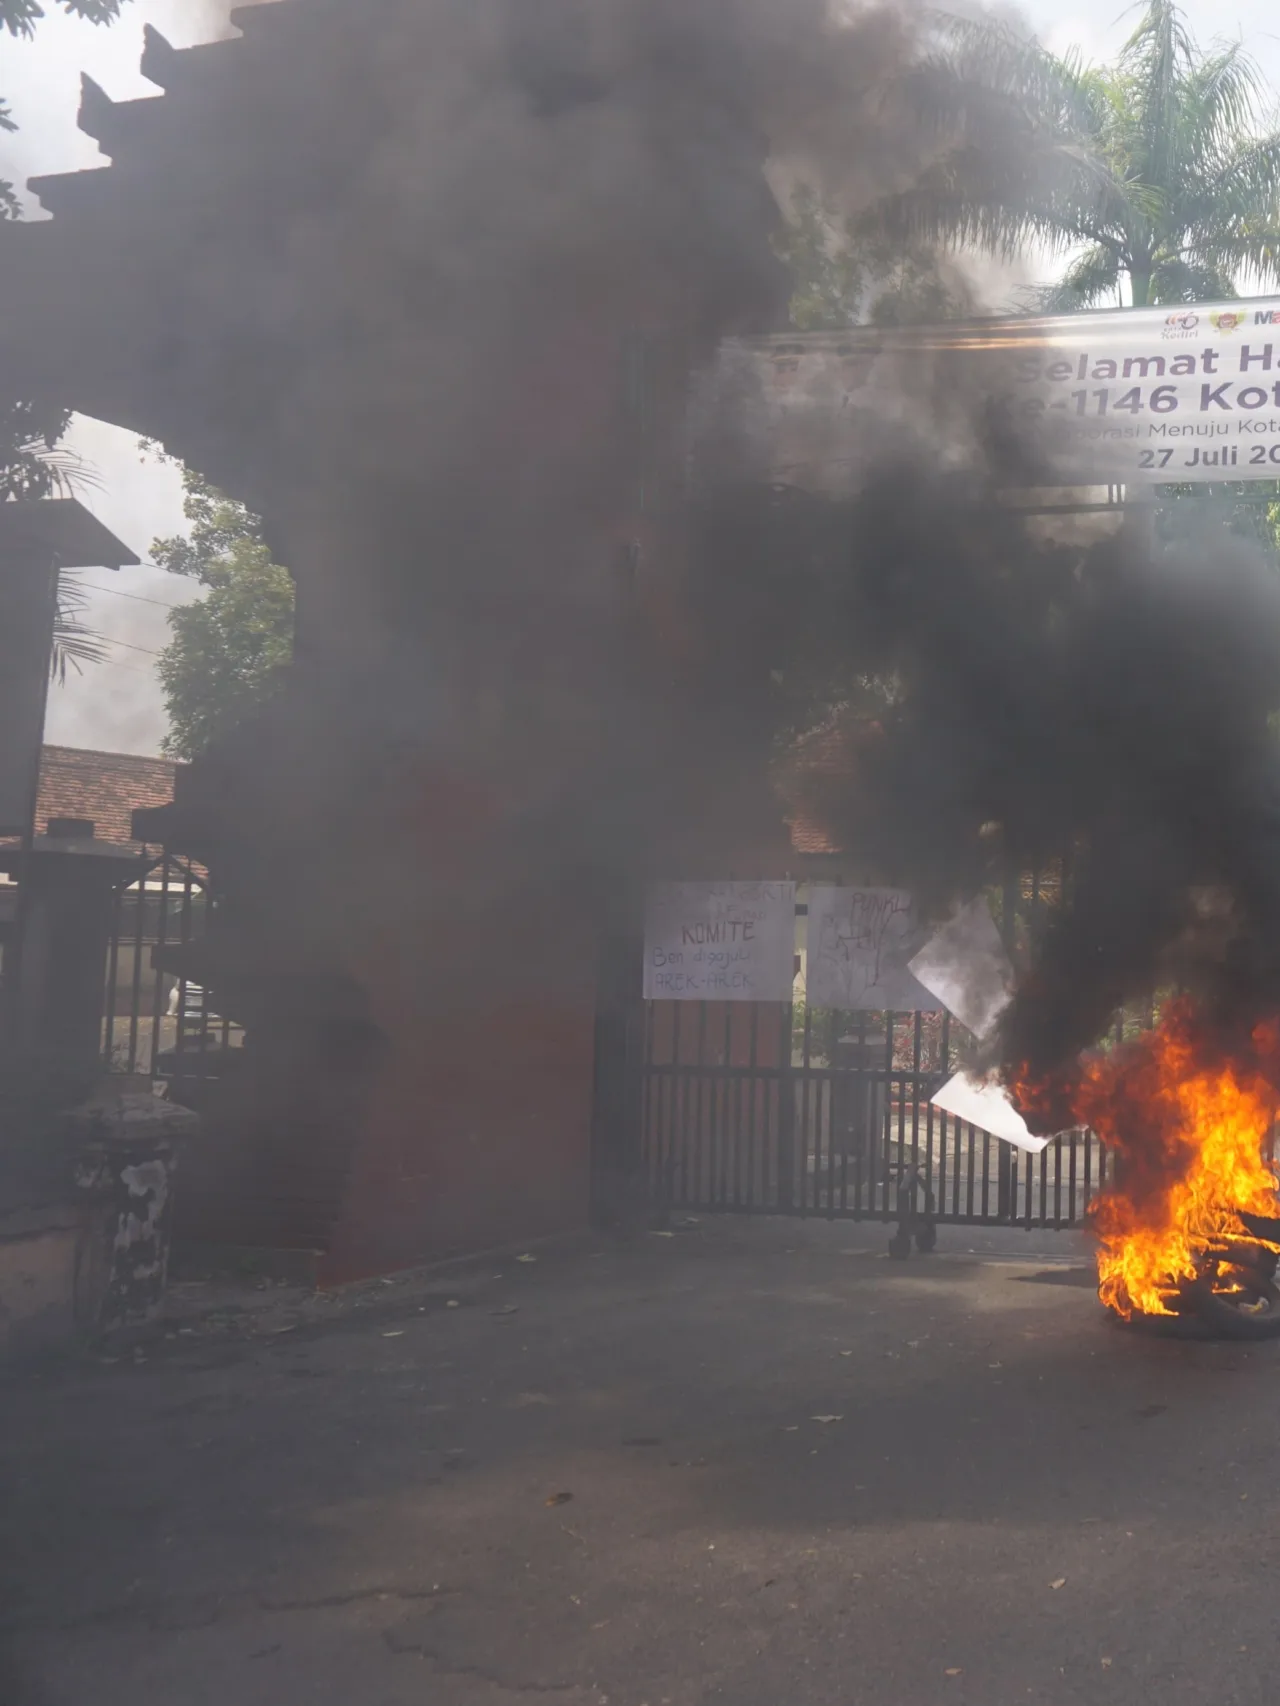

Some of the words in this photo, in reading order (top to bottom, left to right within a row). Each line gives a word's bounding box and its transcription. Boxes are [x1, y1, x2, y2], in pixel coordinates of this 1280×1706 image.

[1015, 346, 1220, 383] Selamat
[1149, 420, 1230, 439] Menuju
[1137, 449, 1176, 470] 27
[1184, 445, 1238, 468] Juli
[682, 920, 756, 945] KOMITE
[652, 946, 684, 967] Ben
[655, 971, 755, 992] AREK-AREK
